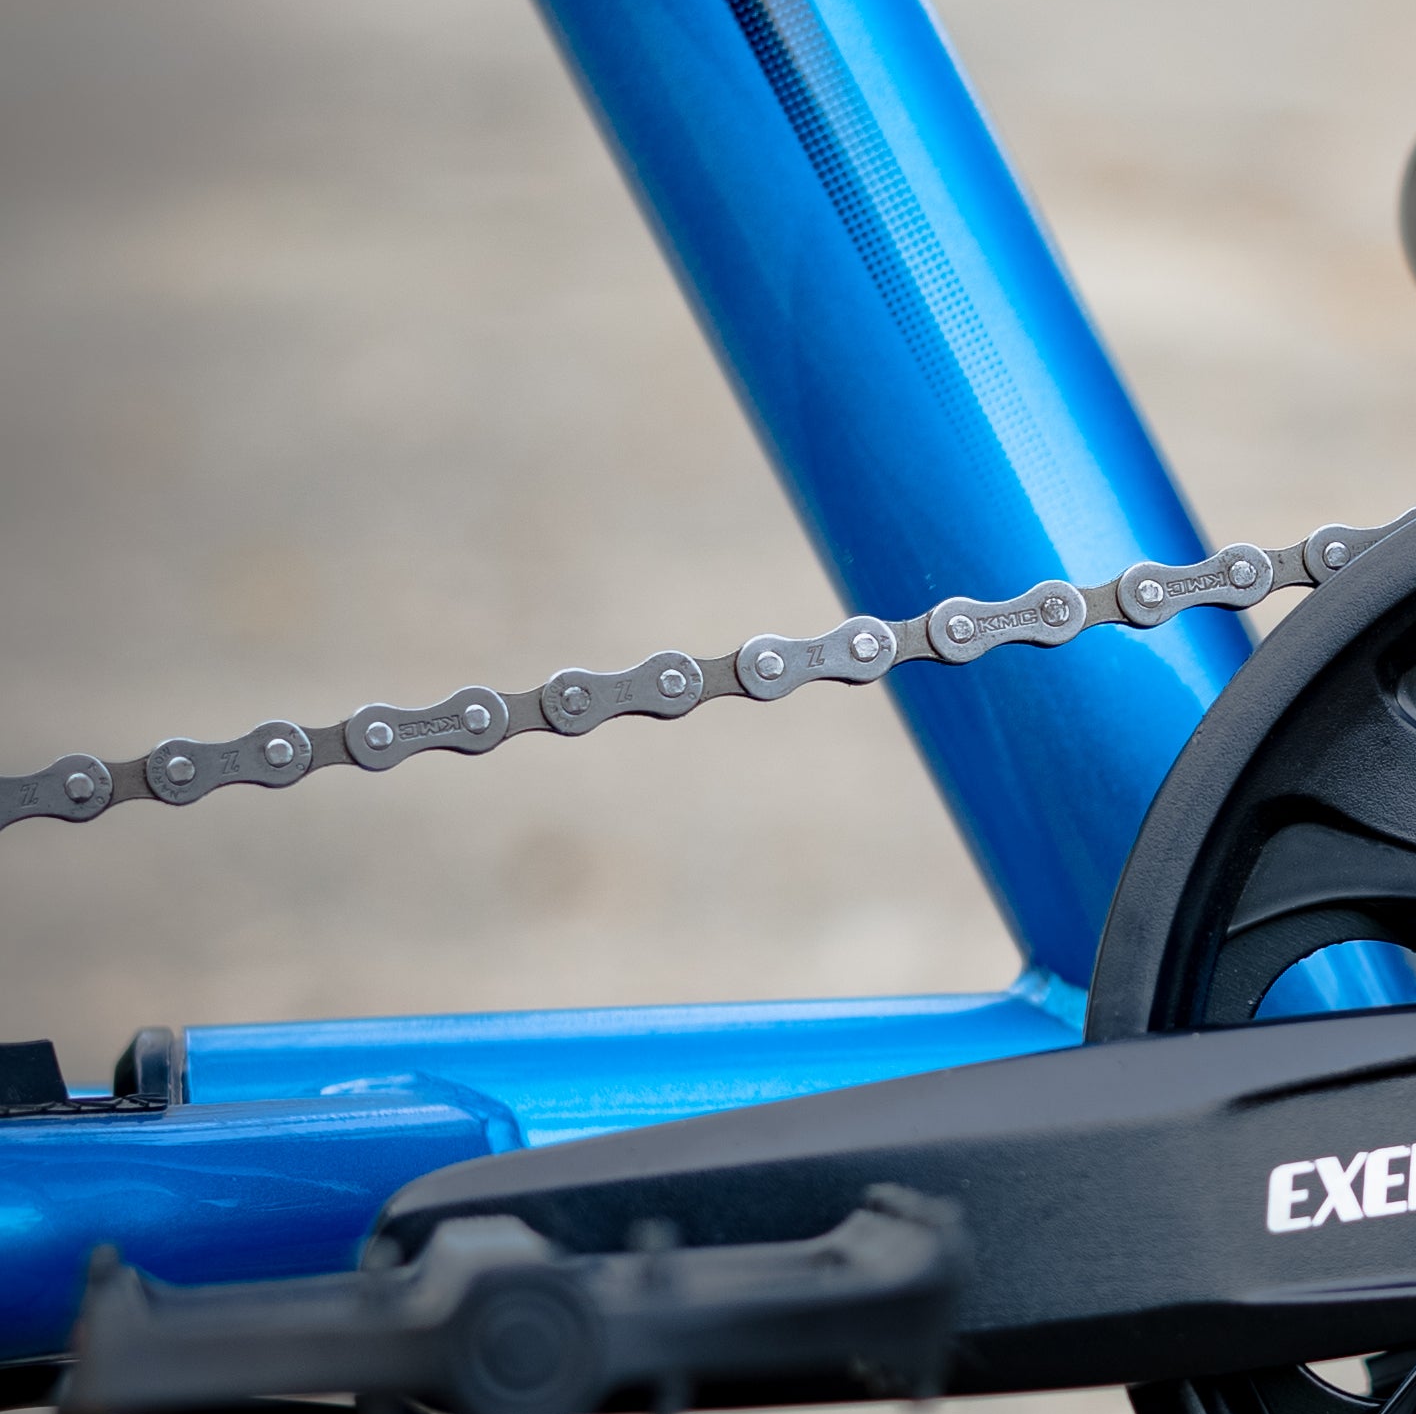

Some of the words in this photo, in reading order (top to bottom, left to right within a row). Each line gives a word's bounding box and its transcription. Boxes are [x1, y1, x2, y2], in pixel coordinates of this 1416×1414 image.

[1165, 572, 1227, 597] KMC
[976, 607, 1040, 634] KMC
[398, 714, 462, 740] KMC
